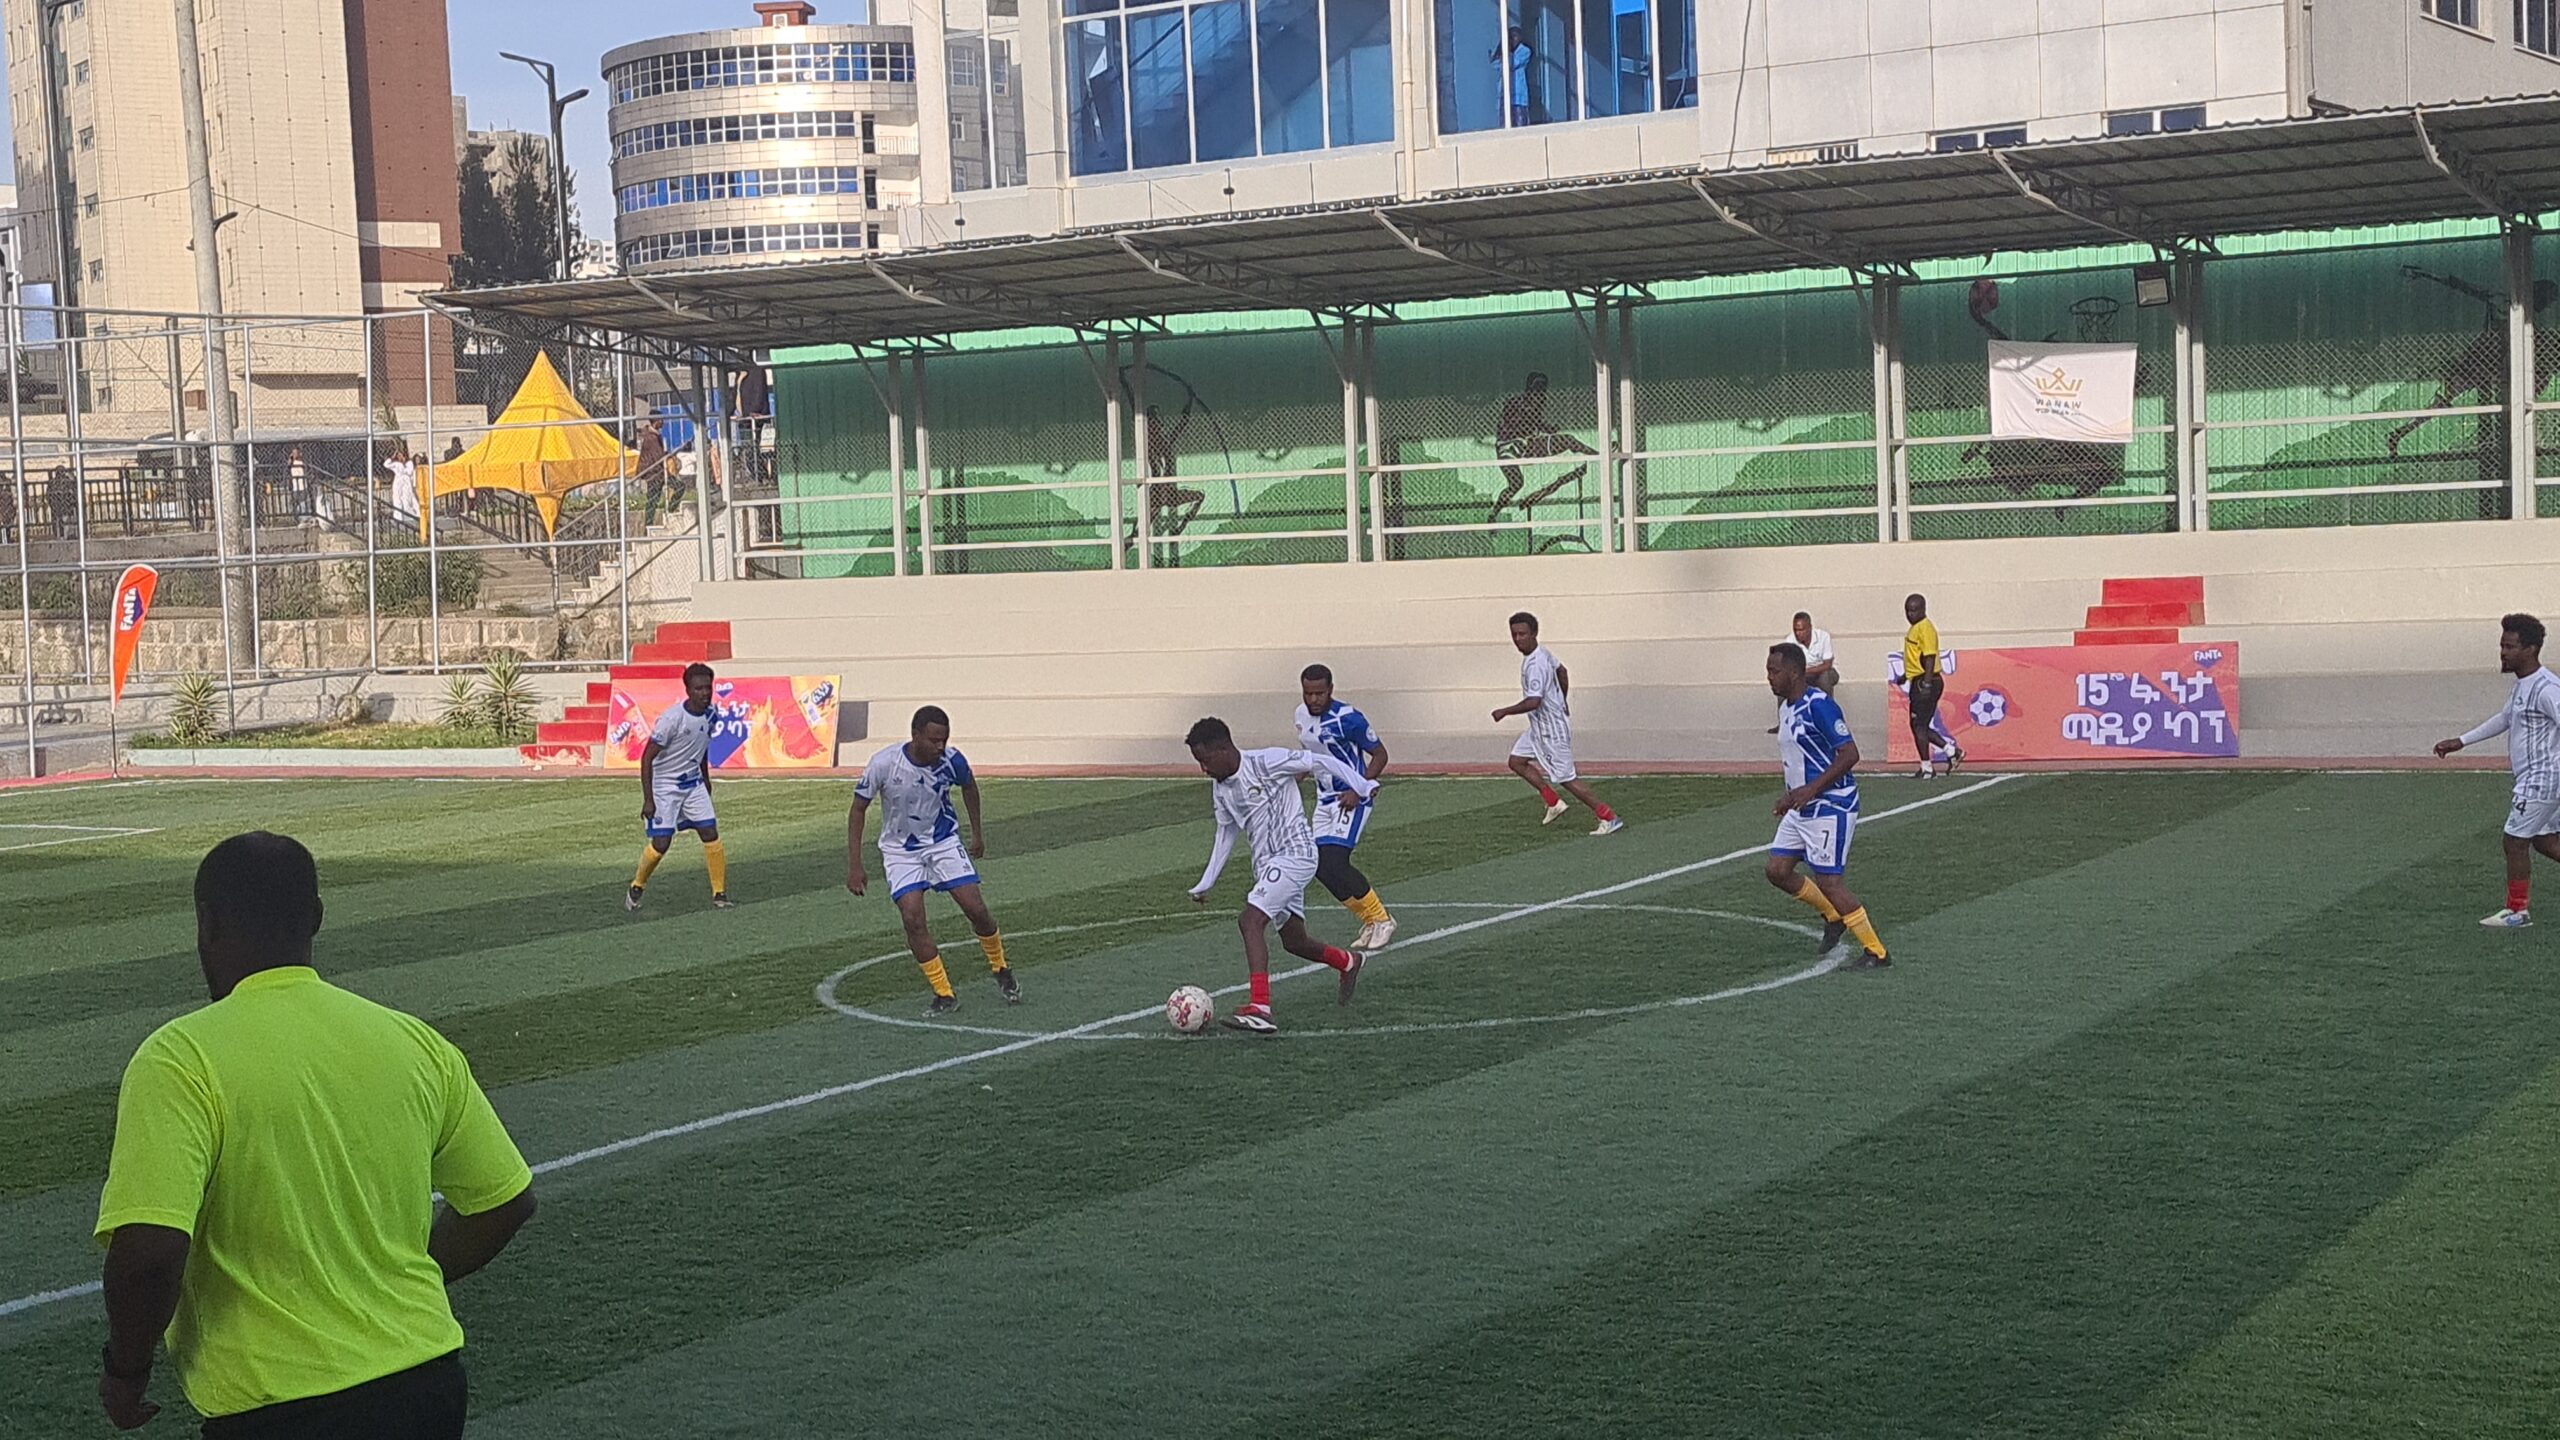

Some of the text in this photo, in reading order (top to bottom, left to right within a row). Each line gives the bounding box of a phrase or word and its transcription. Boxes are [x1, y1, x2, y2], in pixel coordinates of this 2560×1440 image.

[119, 587, 138, 632] FANTA
[2130, 671, 2213, 704] ፋንታ
[2063, 709, 2225, 745] ሚዲያ ካፕ
[1337, 803, 1350, 825] 15
[1821, 829, 1830, 850] 7
[1262, 864, 1282, 883] 10
